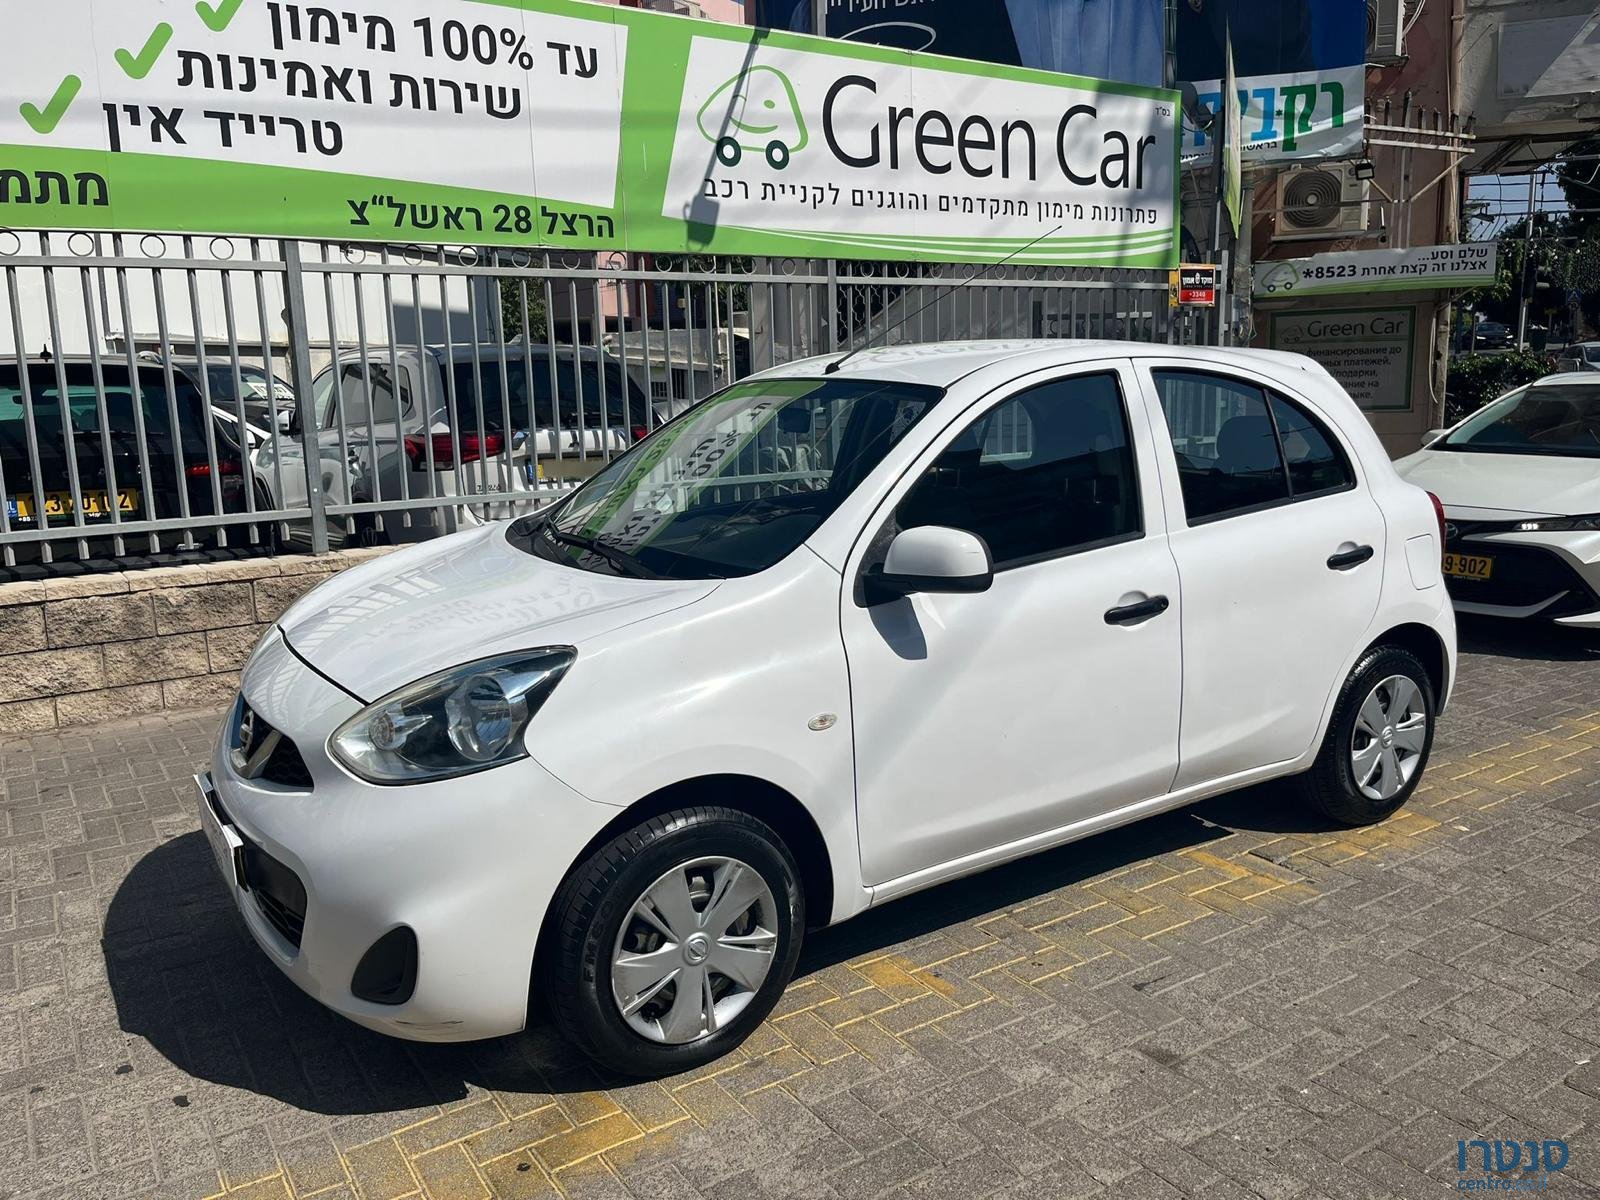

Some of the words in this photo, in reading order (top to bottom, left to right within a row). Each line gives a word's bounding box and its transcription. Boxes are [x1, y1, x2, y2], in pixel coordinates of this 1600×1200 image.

[267, 2, 396, 53] מימון
[414, 17, 534, 71] 100%
[547, 42, 598, 79] עד
[178, 50, 373, 105] ואמינות
[390, 74, 521, 120] שירות
[103, 103, 187, 153] אין
[1279, 81, 1344, 152] רק
[204, 111, 343, 156] טרייד
[823, 75, 1036, 181] Green
[1056, 104, 1157, 190] Car
[703, 178, 749, 200] רכב
[760, 182, 840, 210] לקניית
[852, 189, 928, 211] והוגנים
[347, 195, 483, 232] ראשל"צ
[493, 205, 532, 234] 28
[541, 205, 614, 238] הרצל
[938, 195, 1028, 220] מתקדמים
[1037, 202, 1083, 223] מימון
[1091, 205, 1157, 224] פתרונות
[1431, 262, 1448, 272] זה
[1450, 260, 1488, 272] אצלנו
[1458, 248, 1488, 259] שלם
[1361, 264, 1396, 277] אחרת
[1400, 262, 1428, 276] קצת
[1308, 321, 1364, 338] Green
[1369, 317, 1405, 335] Car
